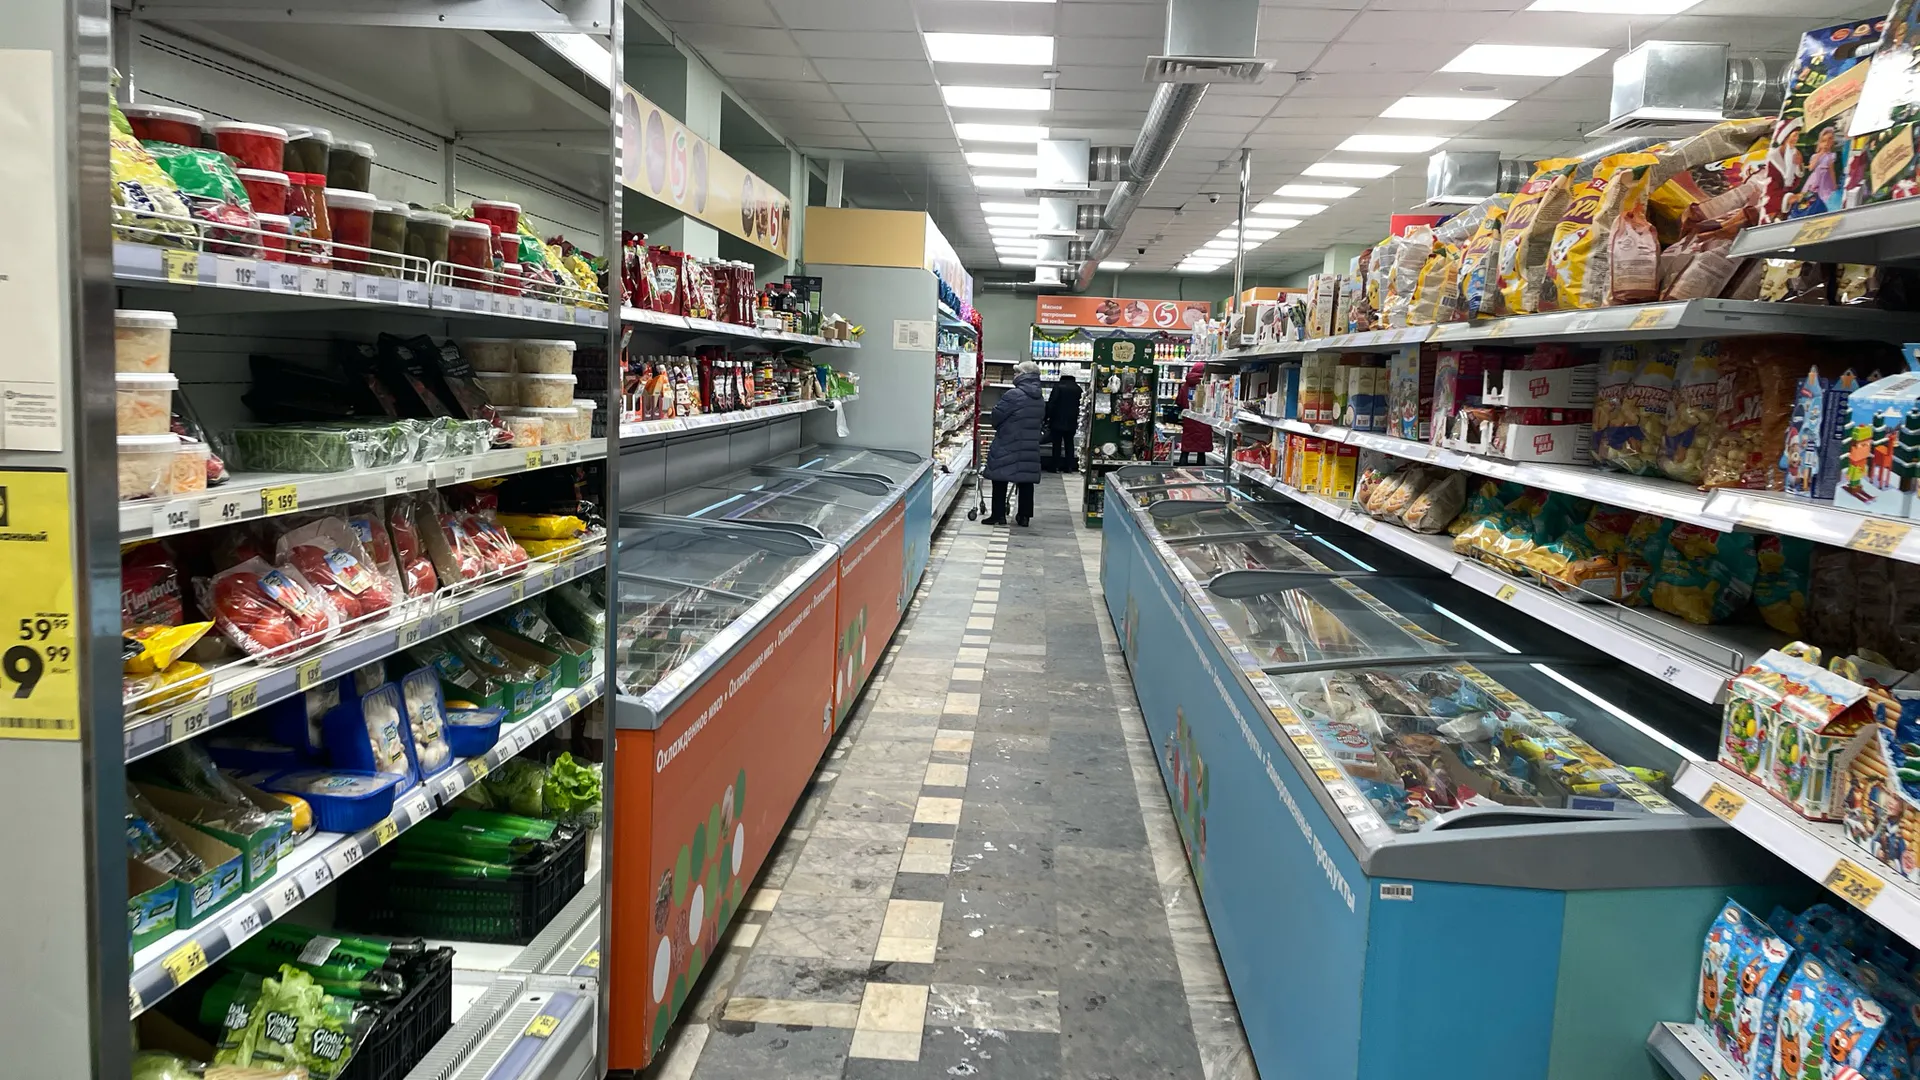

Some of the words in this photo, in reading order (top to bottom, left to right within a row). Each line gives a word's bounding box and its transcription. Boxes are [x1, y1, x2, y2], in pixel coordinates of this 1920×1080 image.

[235, 267, 252, 283] 119
[280, 274, 295, 286] 104
[221, 503, 236, 518] 49
[278, 495, 293, 509] 159
[167, 511, 185, 526] 104
[19, 618, 52, 642] 59
[53, 619, 68, 630] 99
[46, 646, 70, 663] 99
[656, 711, 708, 773] Охлажденное
[708, 695, 723, 721] мясо
[728, 653, 763, 698] Охлажденное
[184, 712, 203, 732] 139
[342, 847, 358, 863] 119
[1312, 833, 1356, 914] продукты
[266, 1011, 297, 1029] Global
[265, 1022, 297, 1044] Village
[313, 1028, 345, 1046] Global
